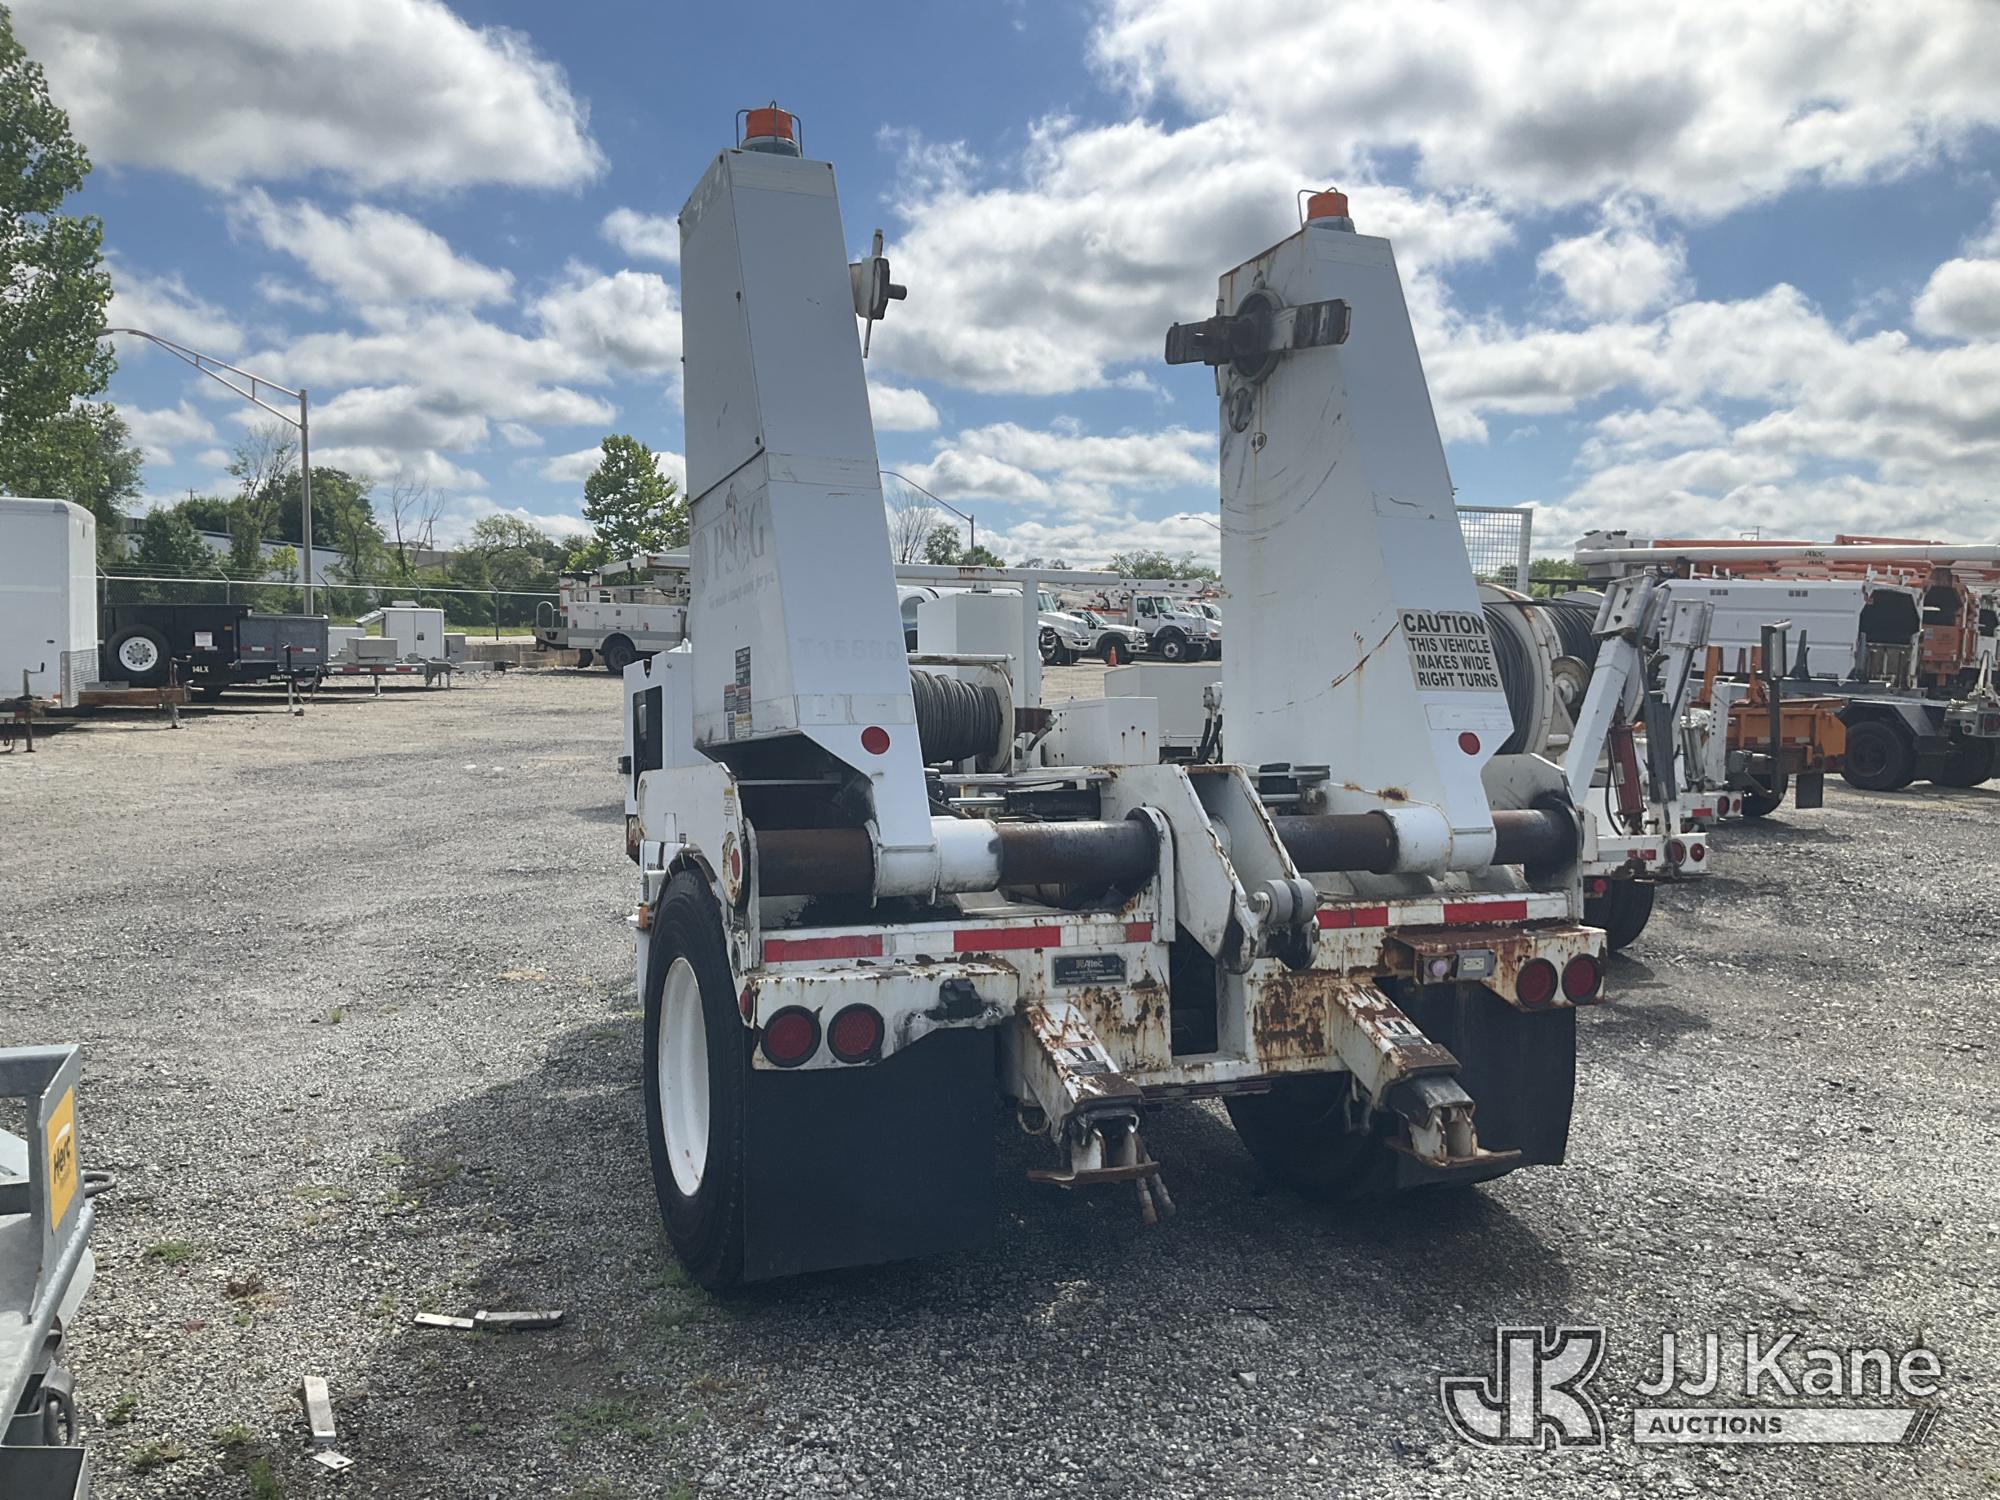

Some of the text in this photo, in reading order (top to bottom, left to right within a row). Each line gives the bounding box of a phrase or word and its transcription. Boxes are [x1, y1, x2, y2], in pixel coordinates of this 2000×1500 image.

[1403, 613, 1485, 634] CAUTION
[1408, 637, 1491, 653] THIS VEHICLE
[1416, 655, 1491, 670] MAKES WIDE
[1417, 671, 1498, 687] RIGHT TURNS
[53, 1135, 71, 1184] Herc
